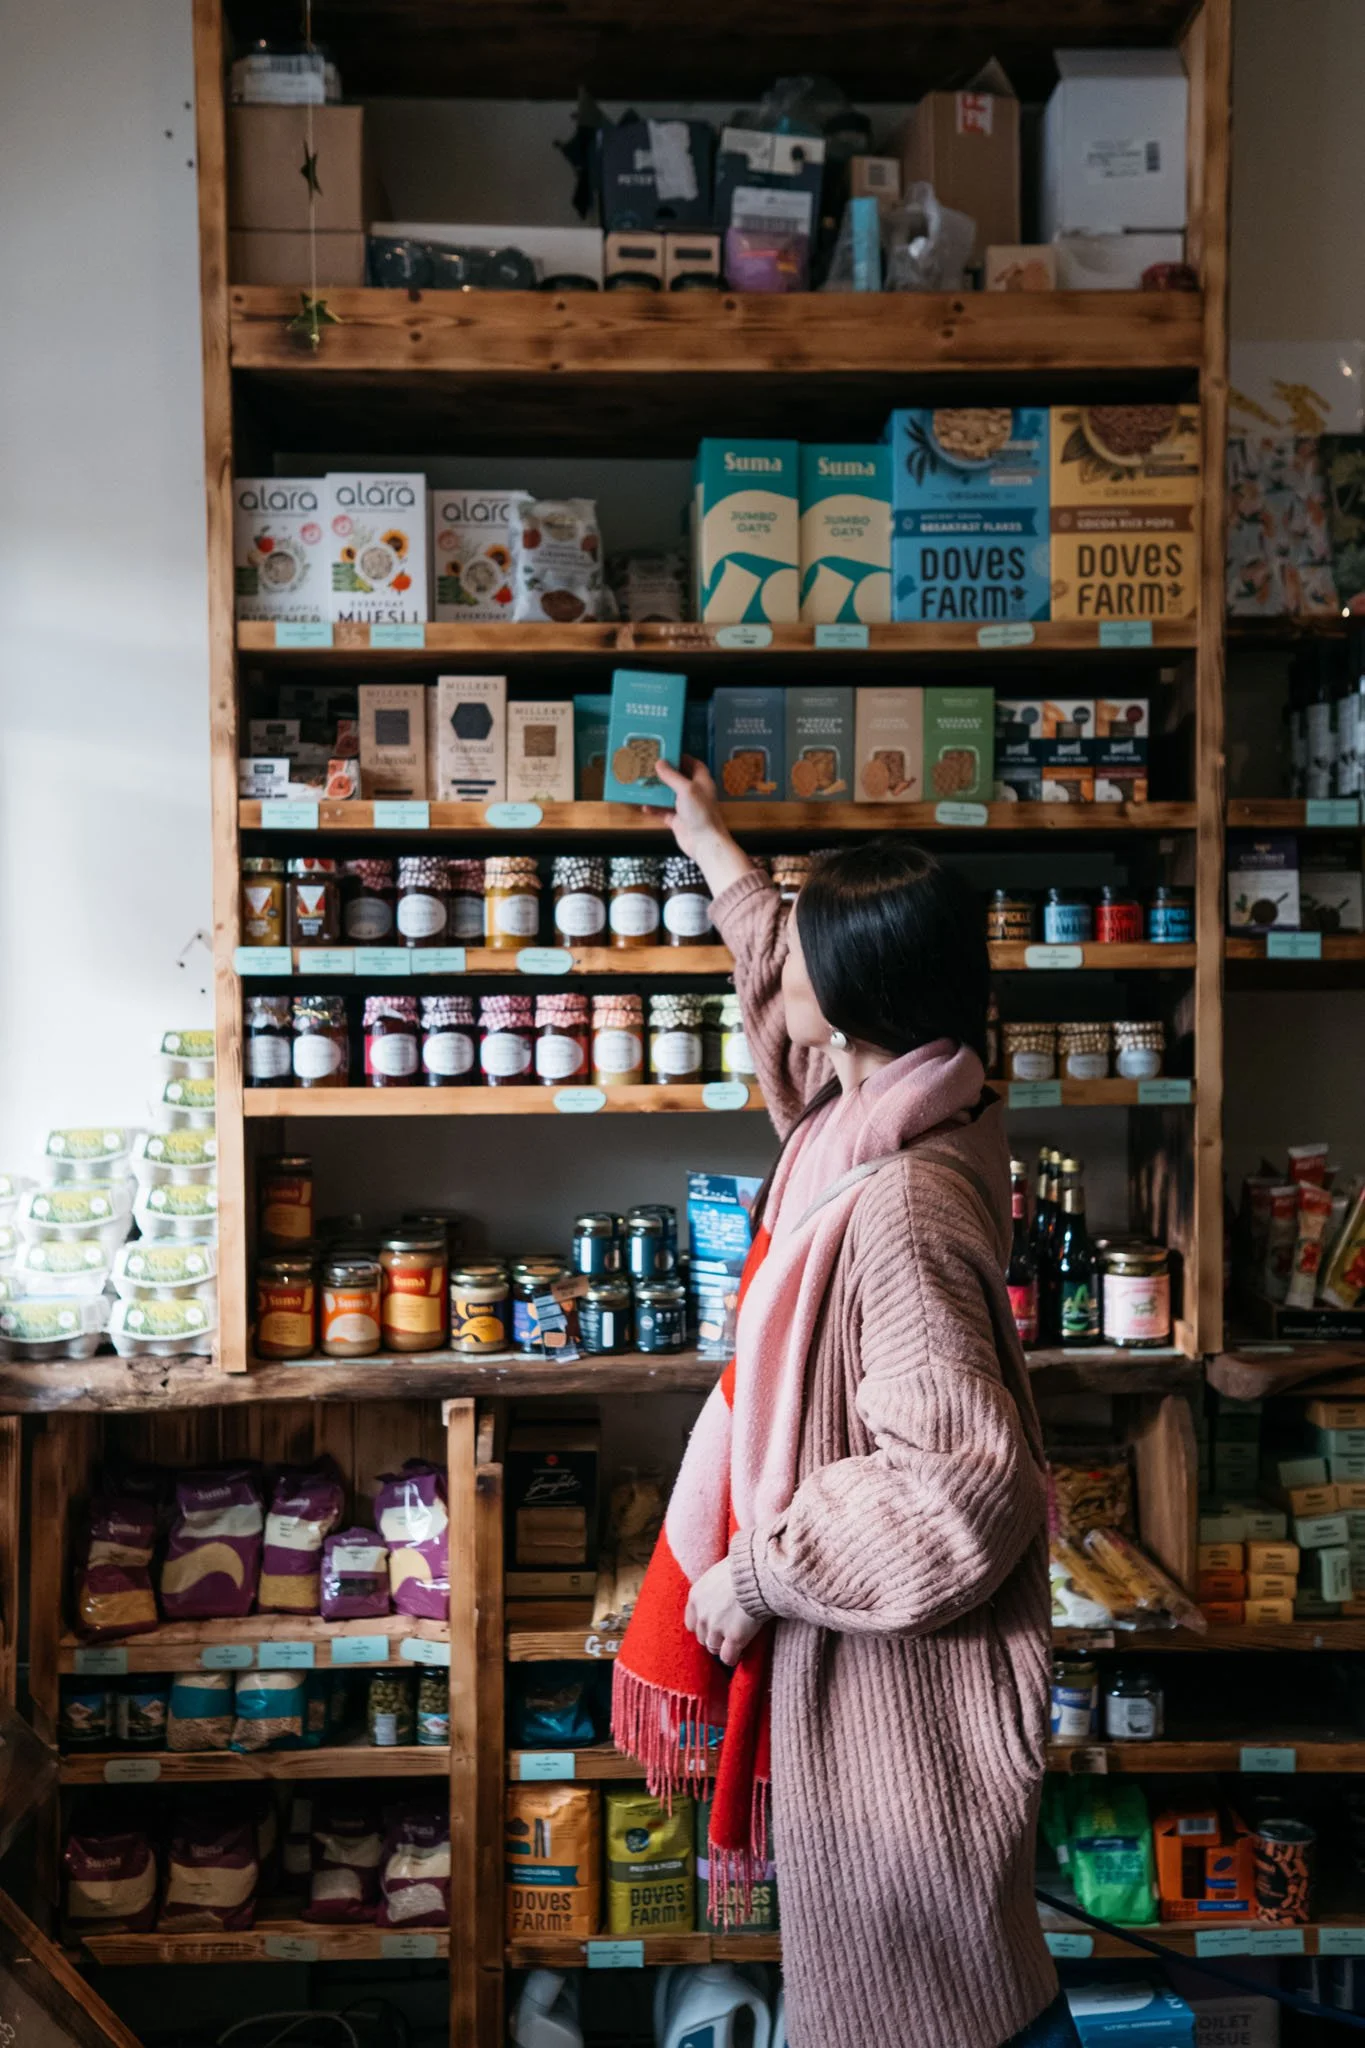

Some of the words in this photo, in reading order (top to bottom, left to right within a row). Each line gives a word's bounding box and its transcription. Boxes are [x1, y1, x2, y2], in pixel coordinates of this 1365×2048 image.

[724, 452, 783, 473] Suma
[818, 456, 876, 477] Suma
[239, 485, 318, 512] alara
[336, 480, 416, 507] alara
[730, 511, 778, 522] JUMBO
[824, 515, 871, 526] JUMBO
[736, 523, 771, 533] OATS
[830, 527, 865, 537] OATS
[920, 522, 981, 533] BREAKFAST
[1200, 2014, 1251, 2030] OILET
